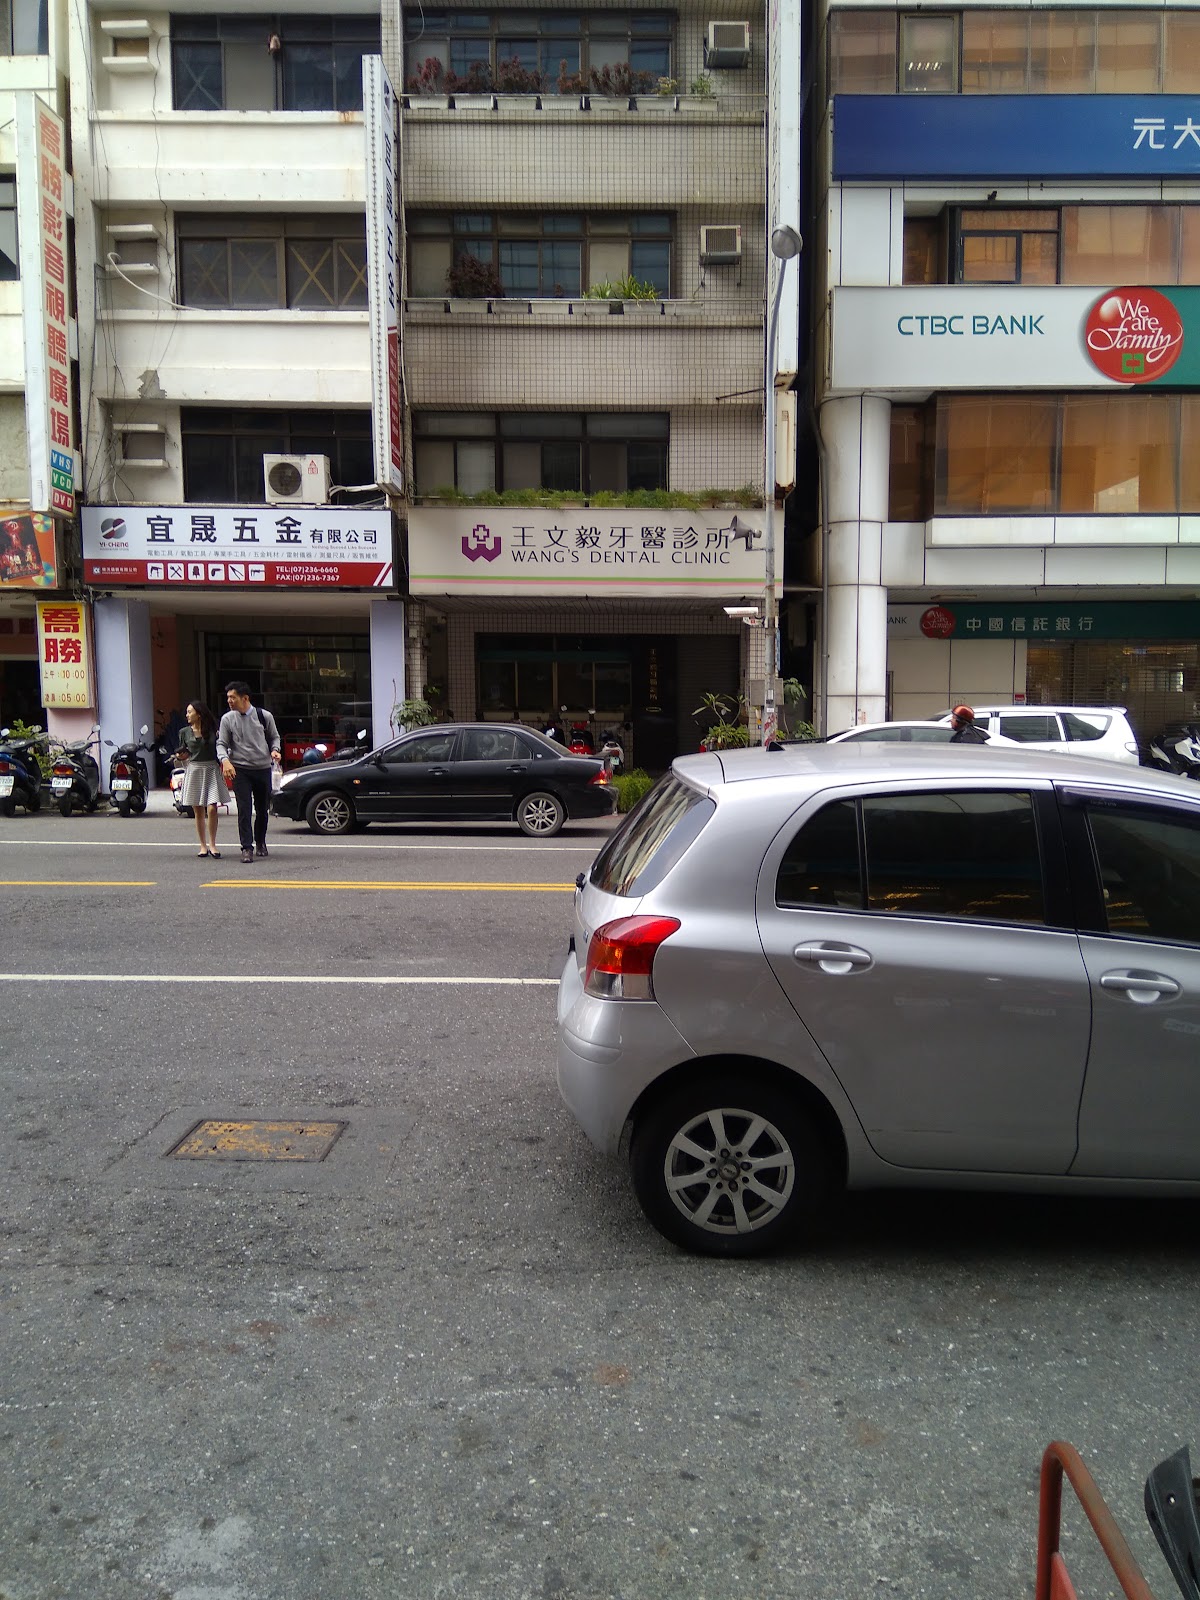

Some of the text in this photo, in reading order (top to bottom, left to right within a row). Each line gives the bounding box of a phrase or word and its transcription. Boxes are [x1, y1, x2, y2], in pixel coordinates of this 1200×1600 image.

[1133, 117, 1200, 149] 元大
[1116, 299, 1150, 319] We
[897, 315, 1045, 336] CTBC BANK
[1119, 316, 1160, 332] care
[1087, 321, 1184, 363] Family
[51, 452, 72, 470] VHS
[52, 473, 72, 490] VCD
[53, 493, 73, 508] DVD
[146, 515, 378, 544] 宜晟五金 有限公司
[510, 525, 730, 549] 王文毅牙醫診所
[511, 549, 731, 564] WANG'S DENTAL CLINIC
[276, 565, 339, 574] TEL:(07)236-6660
[276, 573, 340, 582] FAX:(07)236-7367
[888, 616, 908, 625] ANK
[966, 617, 1094, 632] 中國信託銀行
